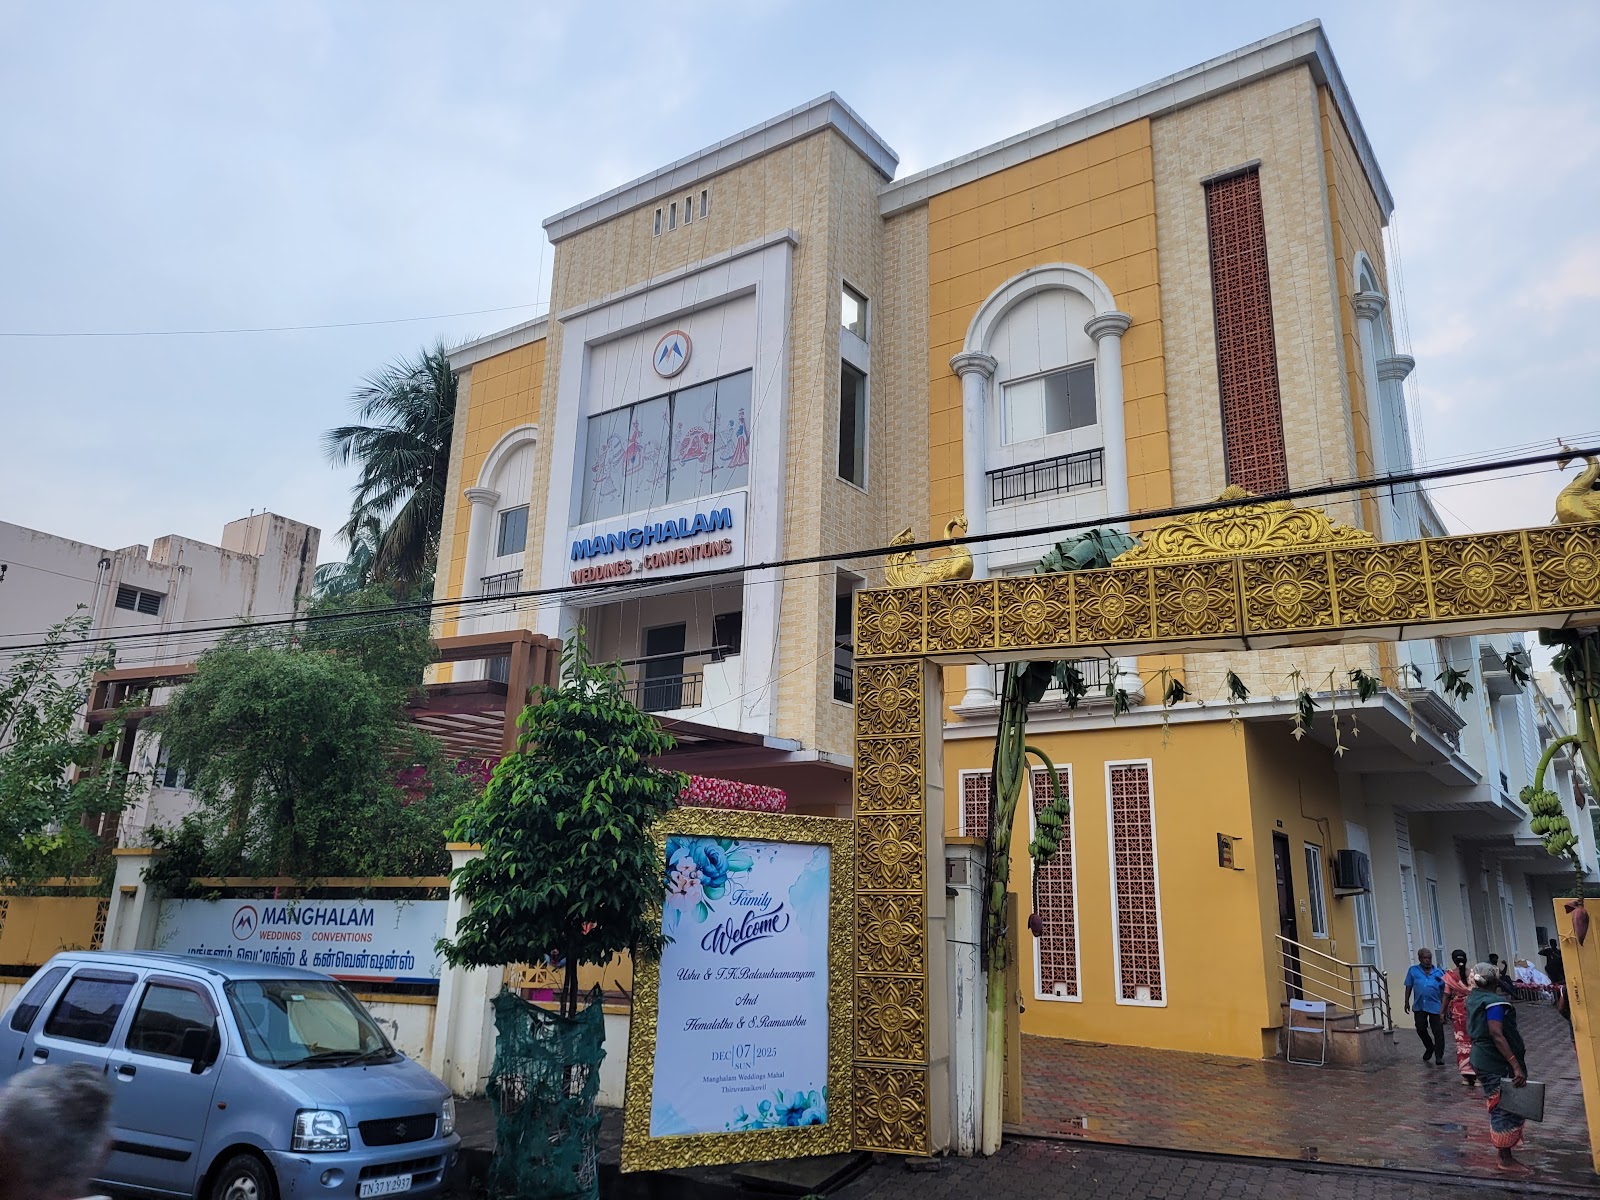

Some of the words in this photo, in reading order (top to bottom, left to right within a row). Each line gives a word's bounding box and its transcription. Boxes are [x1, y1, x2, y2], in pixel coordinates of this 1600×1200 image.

[571, 507, 733, 560] MANGHALAM
[570, 558, 633, 584] WEDDINGS
[644, 538, 732, 569] CONVENTIONS
[729, 889, 773, 911] Family
[261, 907, 374, 927] MANGHALAM
[259, 931, 302, 941] WEDDINGS
[312, 932, 372, 942] CONVENTIONS
[701, 902, 790, 956] Welcome
[299, 949, 308, 967] &
[313, 947, 415, 972] கன்வென்ஷன்ஸ்
[676, 967, 701, 981] Usha
[703, 967, 713, 981] &
[735, 993, 760, 1006] And
[683, 1017, 734, 1032] Hemalatha
[736, 1016, 745, 1029] &
[711, 1051, 732, 1061] DEC
[736, 1044, 751, 1058] 07
[756, 1047, 777, 1058] 2025
[734, 1062, 752, 1070] SUN
[702, 1075, 737, 1084] Manghalam
[738, 1072, 766, 1080] Weddings
[767, 1071, 785, 1079] Mahal
[362, 1183, 374, 1195] TN
[374, 1182, 385, 1194] 37
[386, 1181, 391, 1192] Y
